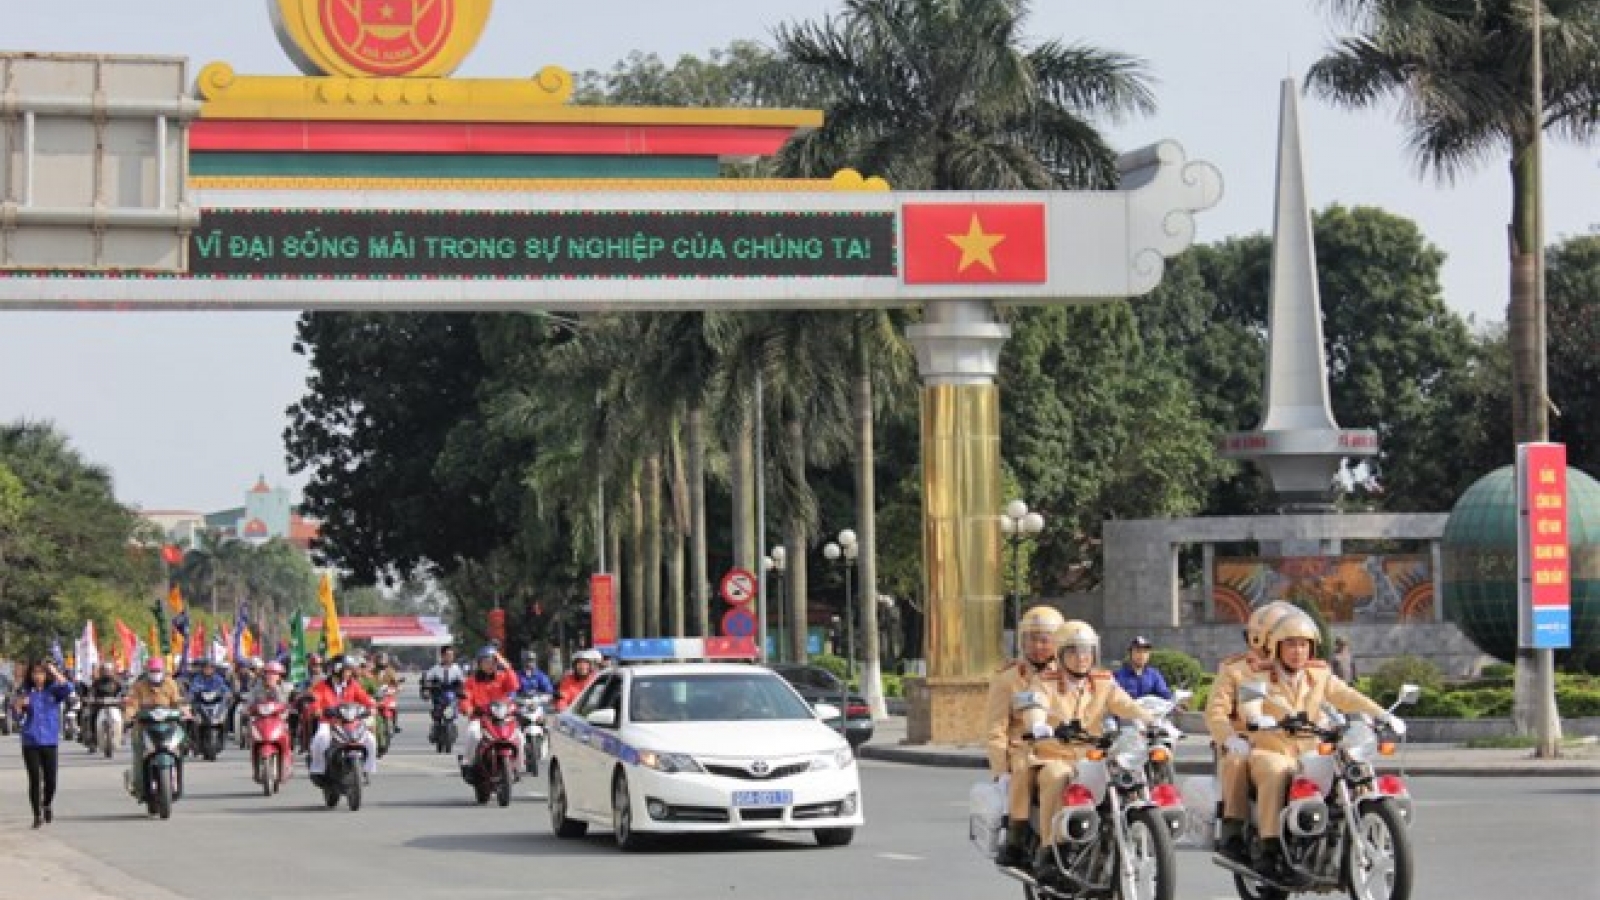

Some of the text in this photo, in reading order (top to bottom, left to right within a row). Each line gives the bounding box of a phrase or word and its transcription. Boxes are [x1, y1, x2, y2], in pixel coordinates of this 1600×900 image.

[196, 226, 872, 263] VĨ ĐẠI SỐNG MÃI TRONG SỰ NGHIỆP CỦA CHÚNG TA!
